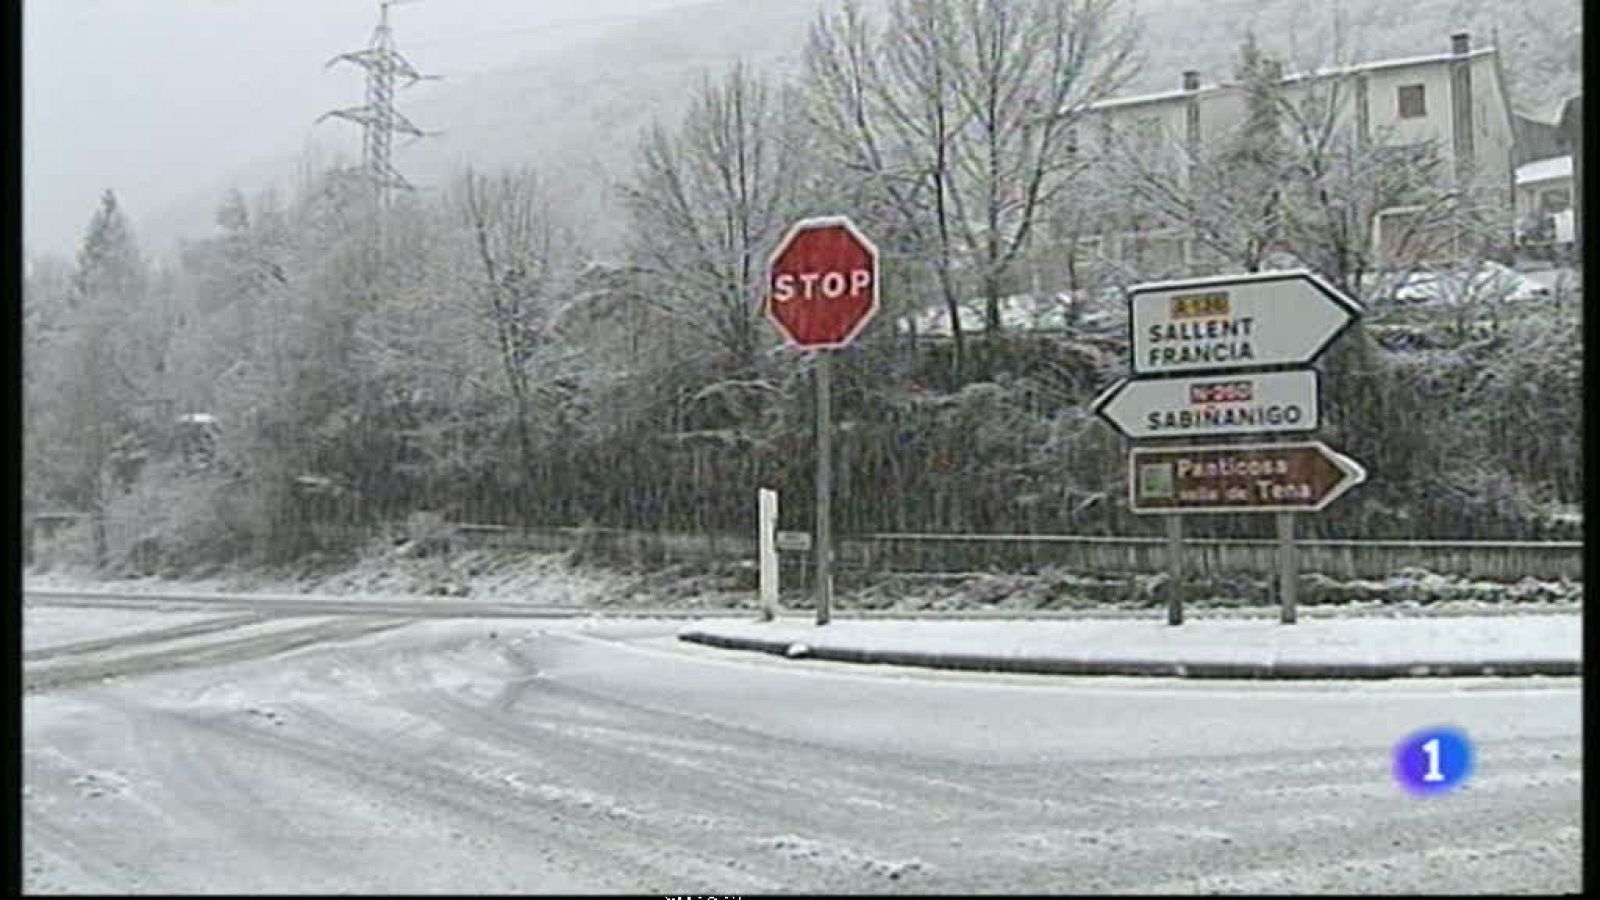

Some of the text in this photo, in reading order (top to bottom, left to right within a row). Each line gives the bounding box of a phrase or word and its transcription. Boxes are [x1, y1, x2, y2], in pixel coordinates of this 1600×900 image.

[773, 269, 871, 302] STOP
[1148, 318, 1254, 343] SALLENT
[1148, 342, 1255, 366] FRANCIA
[1176, 458, 1288, 479] Panticosa
[1256, 480, 1312, 500] Tena
